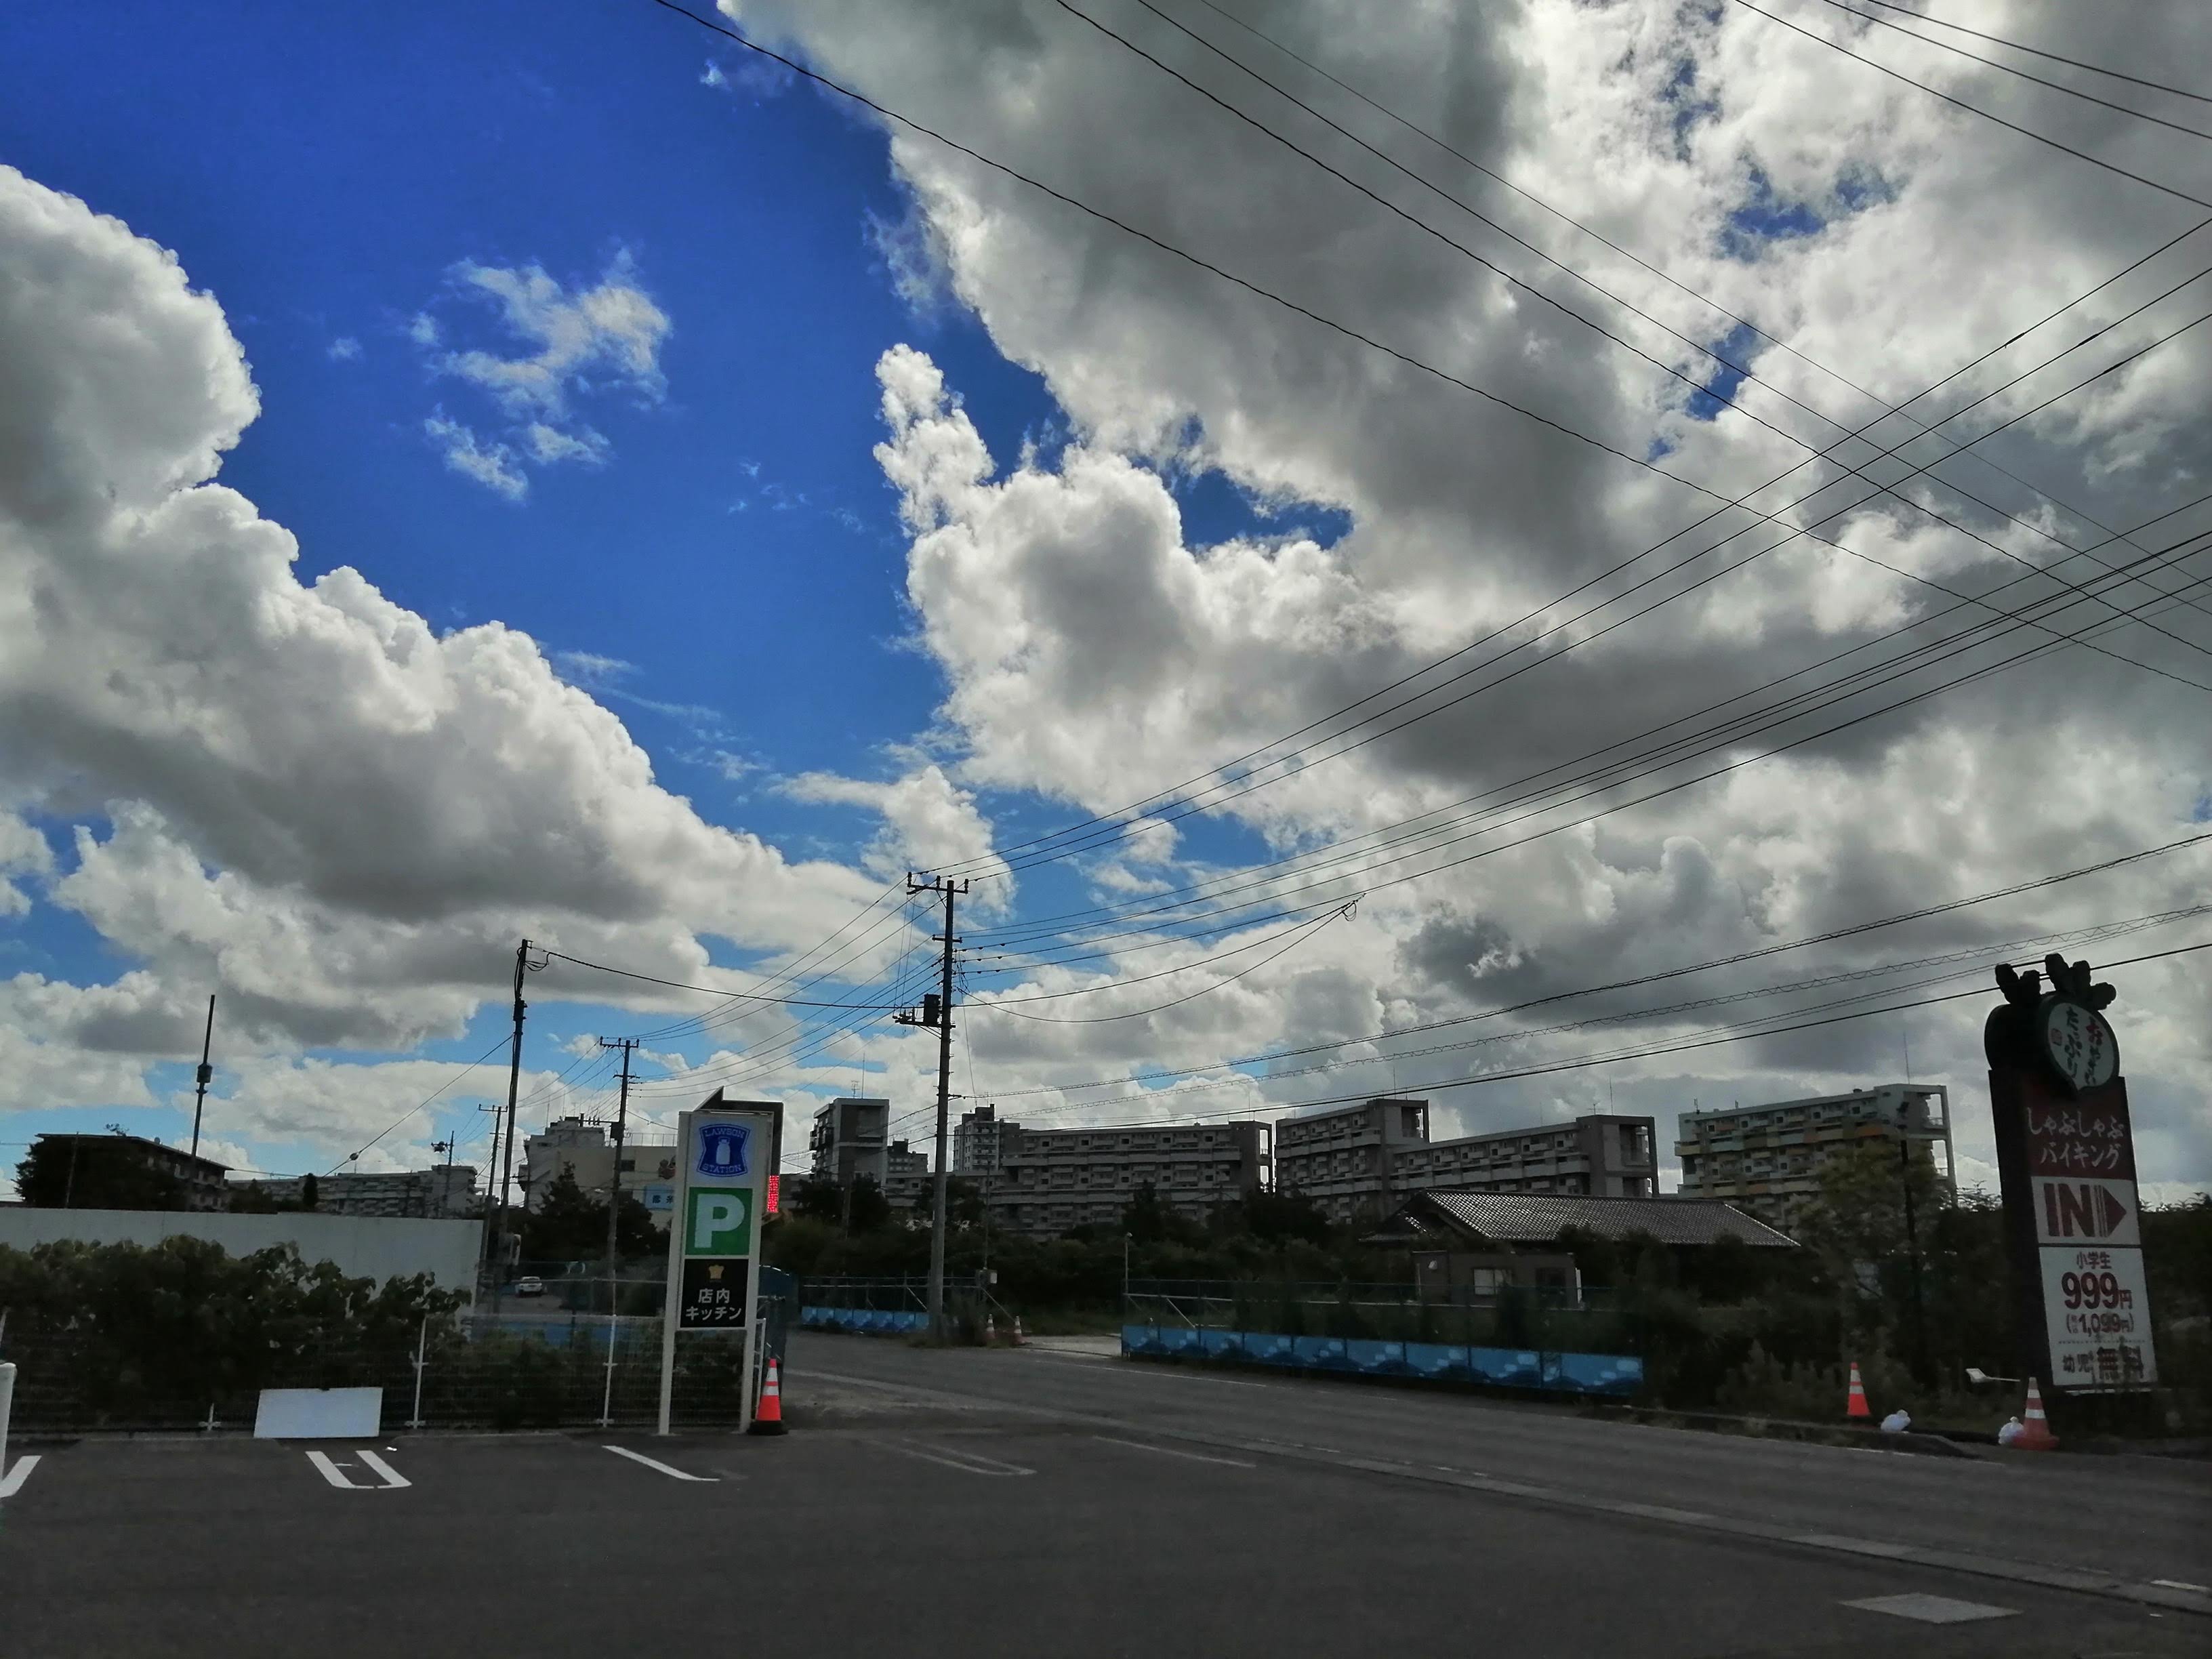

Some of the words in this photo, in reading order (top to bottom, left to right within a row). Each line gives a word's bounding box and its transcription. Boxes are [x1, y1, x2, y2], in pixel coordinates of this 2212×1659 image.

[704, 1128, 745, 1139] LAWSON
[2026, 1106, 2125, 1139] しゃぶしゃぶ
[2039, 1136, 2122, 1170] バイキング
[702, 1163, 743, 1173] STATION
[694, 1193, 745, 1249] P
[2043, 1183, 2096, 1238] IN
[2076, 1251, 2112, 1270] 小学生
[697, 1287, 731, 1305] 店内
[2061, 1271, 2134, 1311] 999円
[685, 1305, 743, 1321] キッチン
